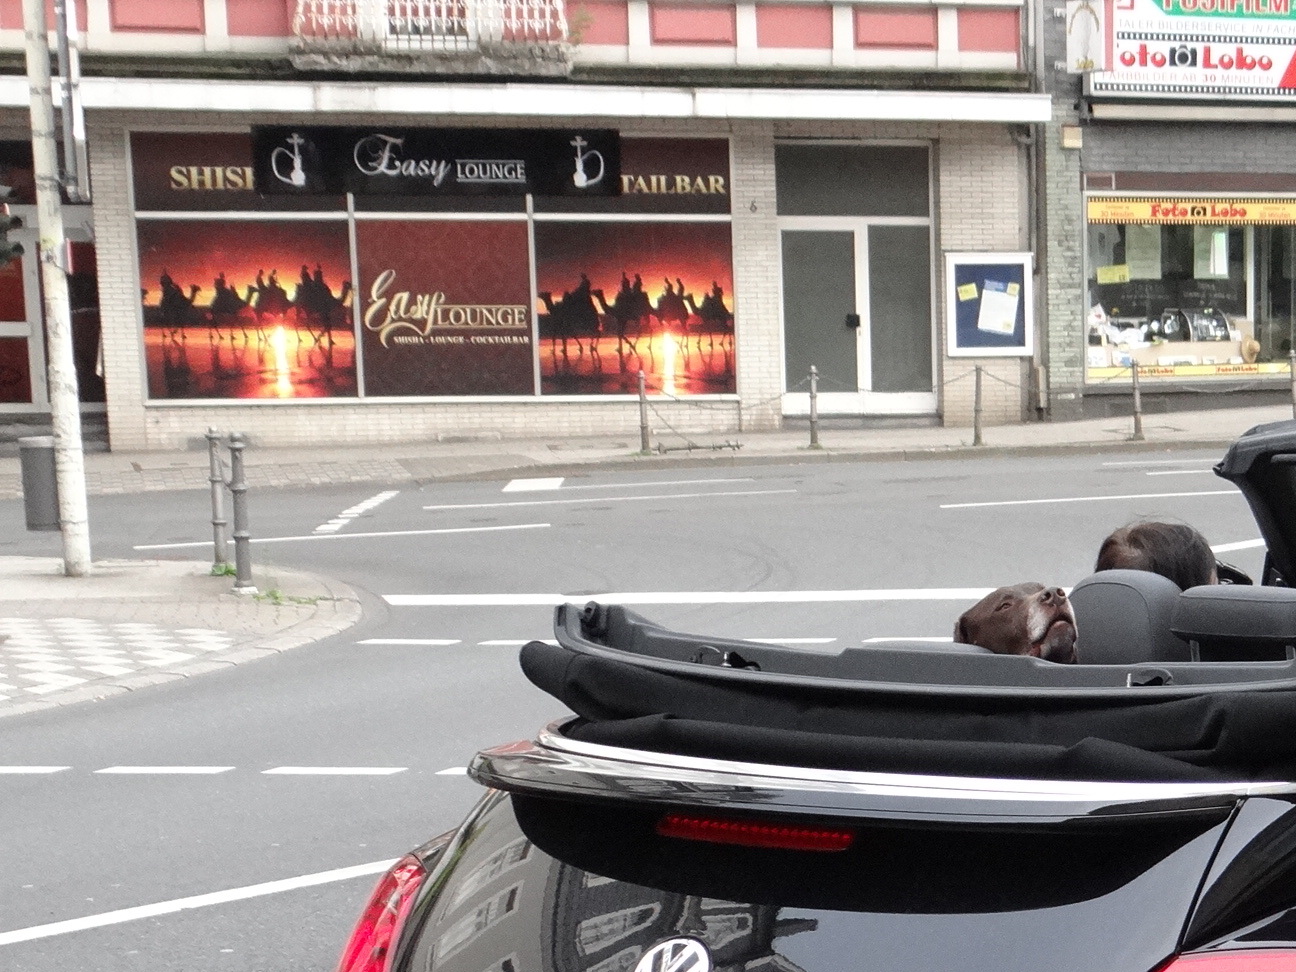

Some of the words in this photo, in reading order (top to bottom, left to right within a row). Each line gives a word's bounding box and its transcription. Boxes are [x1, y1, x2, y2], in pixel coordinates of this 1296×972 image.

[1118, 43, 1167, 68] oto
[1202, 45, 1273, 71] Lobo
[352, 132, 451, 188] Easy
[456, 161, 527, 182] LOUNGE
[1150, 203, 1188, 218] Foto
[1210, 203, 1247, 218] Lobo
[364, 269, 446, 349] Easy
[436, 306, 528, 326] LOUNGE
[392, 335, 424, 345] SHISHA
[430, 335, 464, 345] LOUNGE
[470, 335, 529, 345] COCKTAILBAR
